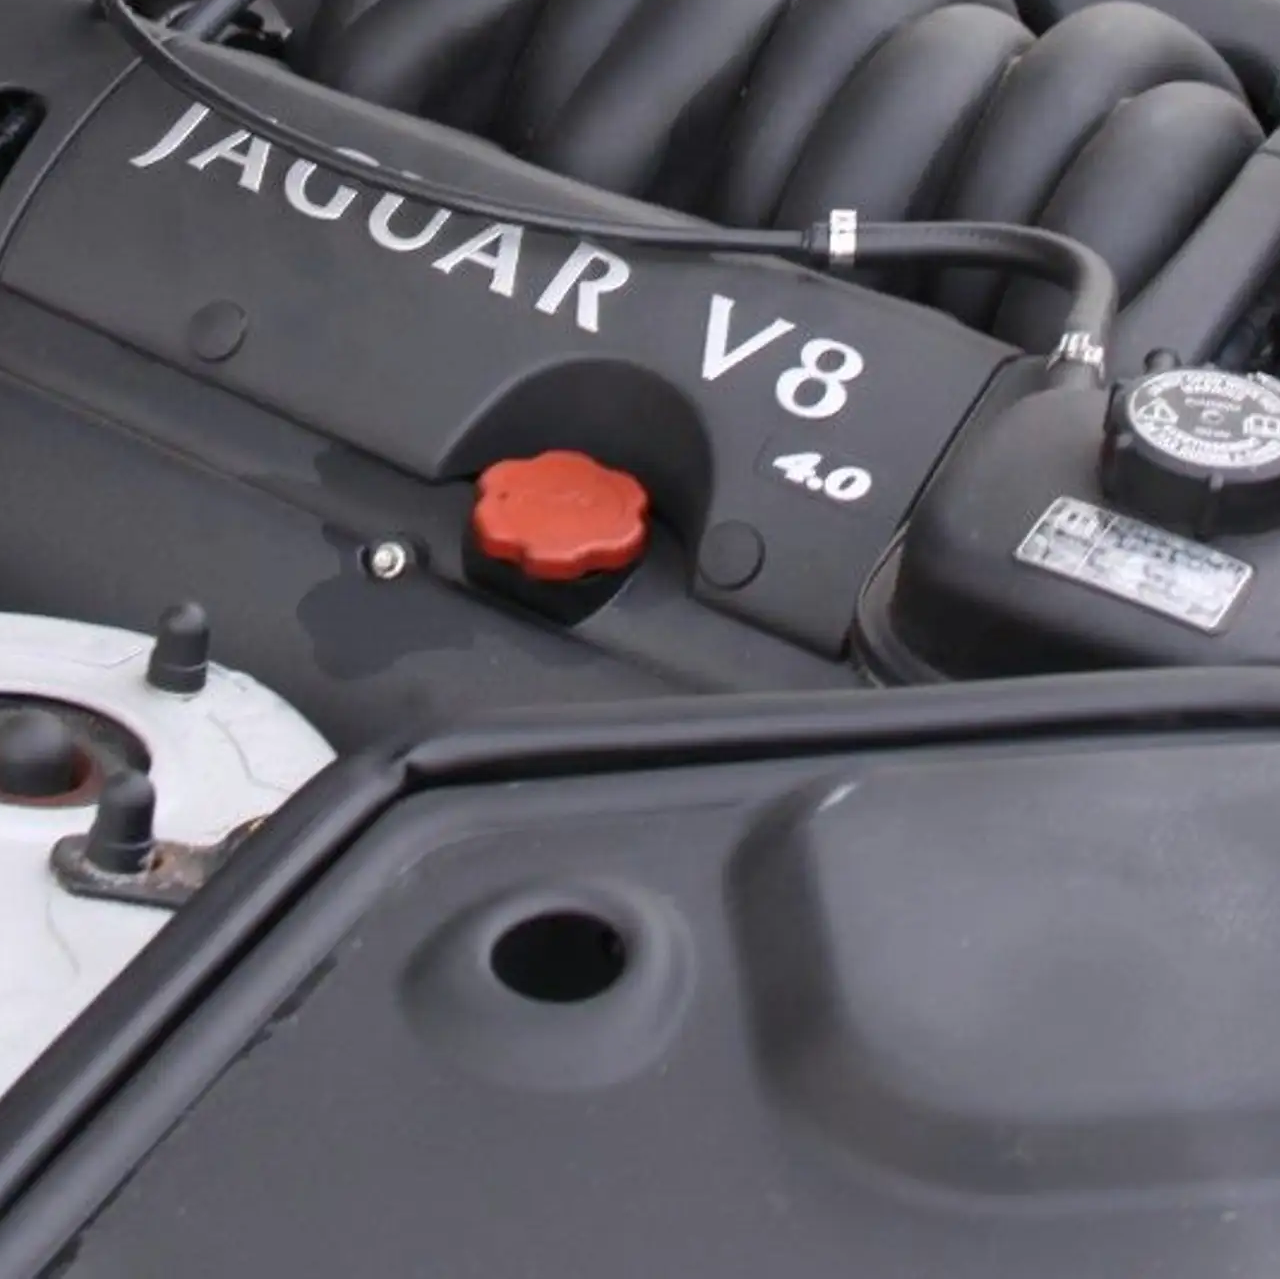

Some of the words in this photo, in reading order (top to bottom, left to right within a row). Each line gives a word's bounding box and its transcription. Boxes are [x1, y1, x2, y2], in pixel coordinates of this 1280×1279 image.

[128, 102, 632, 333] JAGUAR
[702, 294, 864, 419] V8
[772, 452, 872, 501] 4.0
